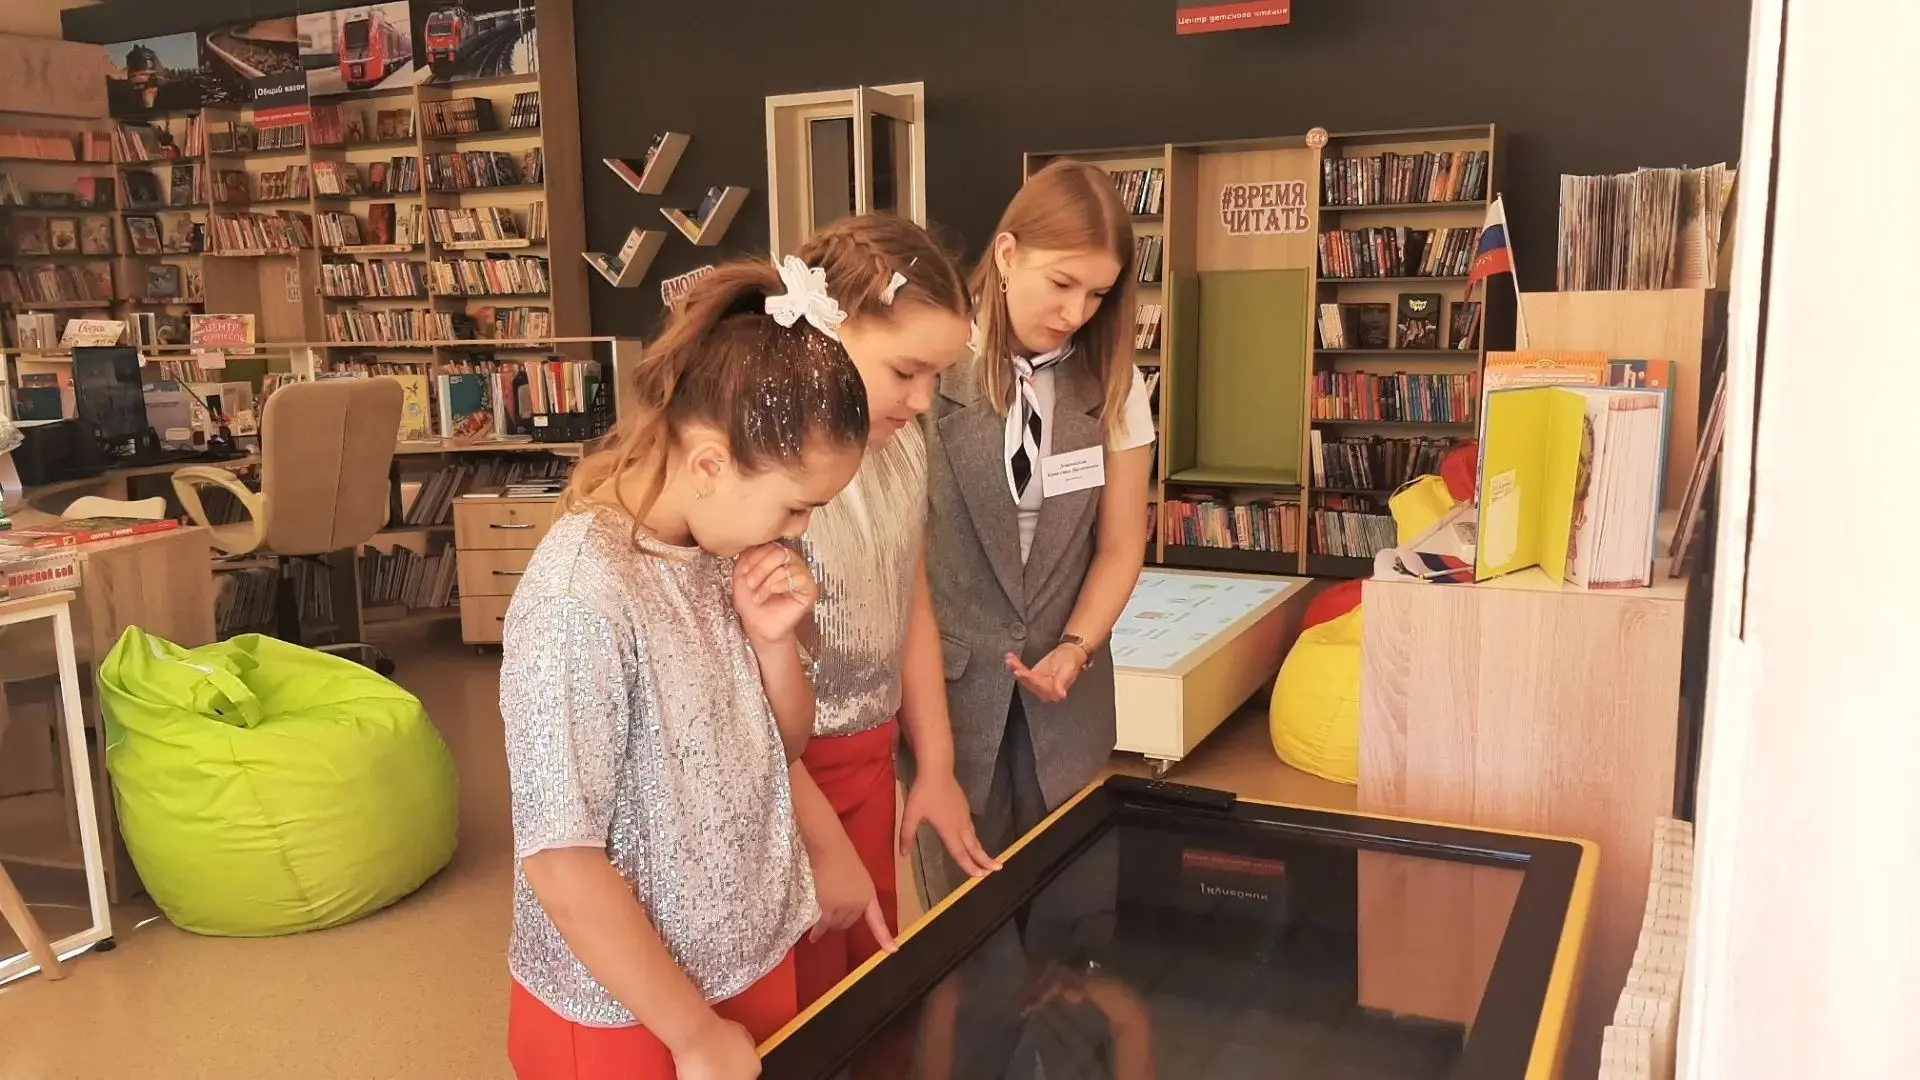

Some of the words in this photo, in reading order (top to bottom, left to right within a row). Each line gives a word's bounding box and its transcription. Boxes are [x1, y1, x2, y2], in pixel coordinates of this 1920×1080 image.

[1178, 16, 1207, 24] Центр
[257, 85, 283, 96] Общий
[284, 84, 305, 93] вагон
[1222, 183, 1305, 210] #ВРЕМЯ
[1222, 208, 1309, 233] ЧИТАТЬ
[8, 568, 54, 587] МОРСКОЙ
[54, 564, 74, 579] БОЙ
